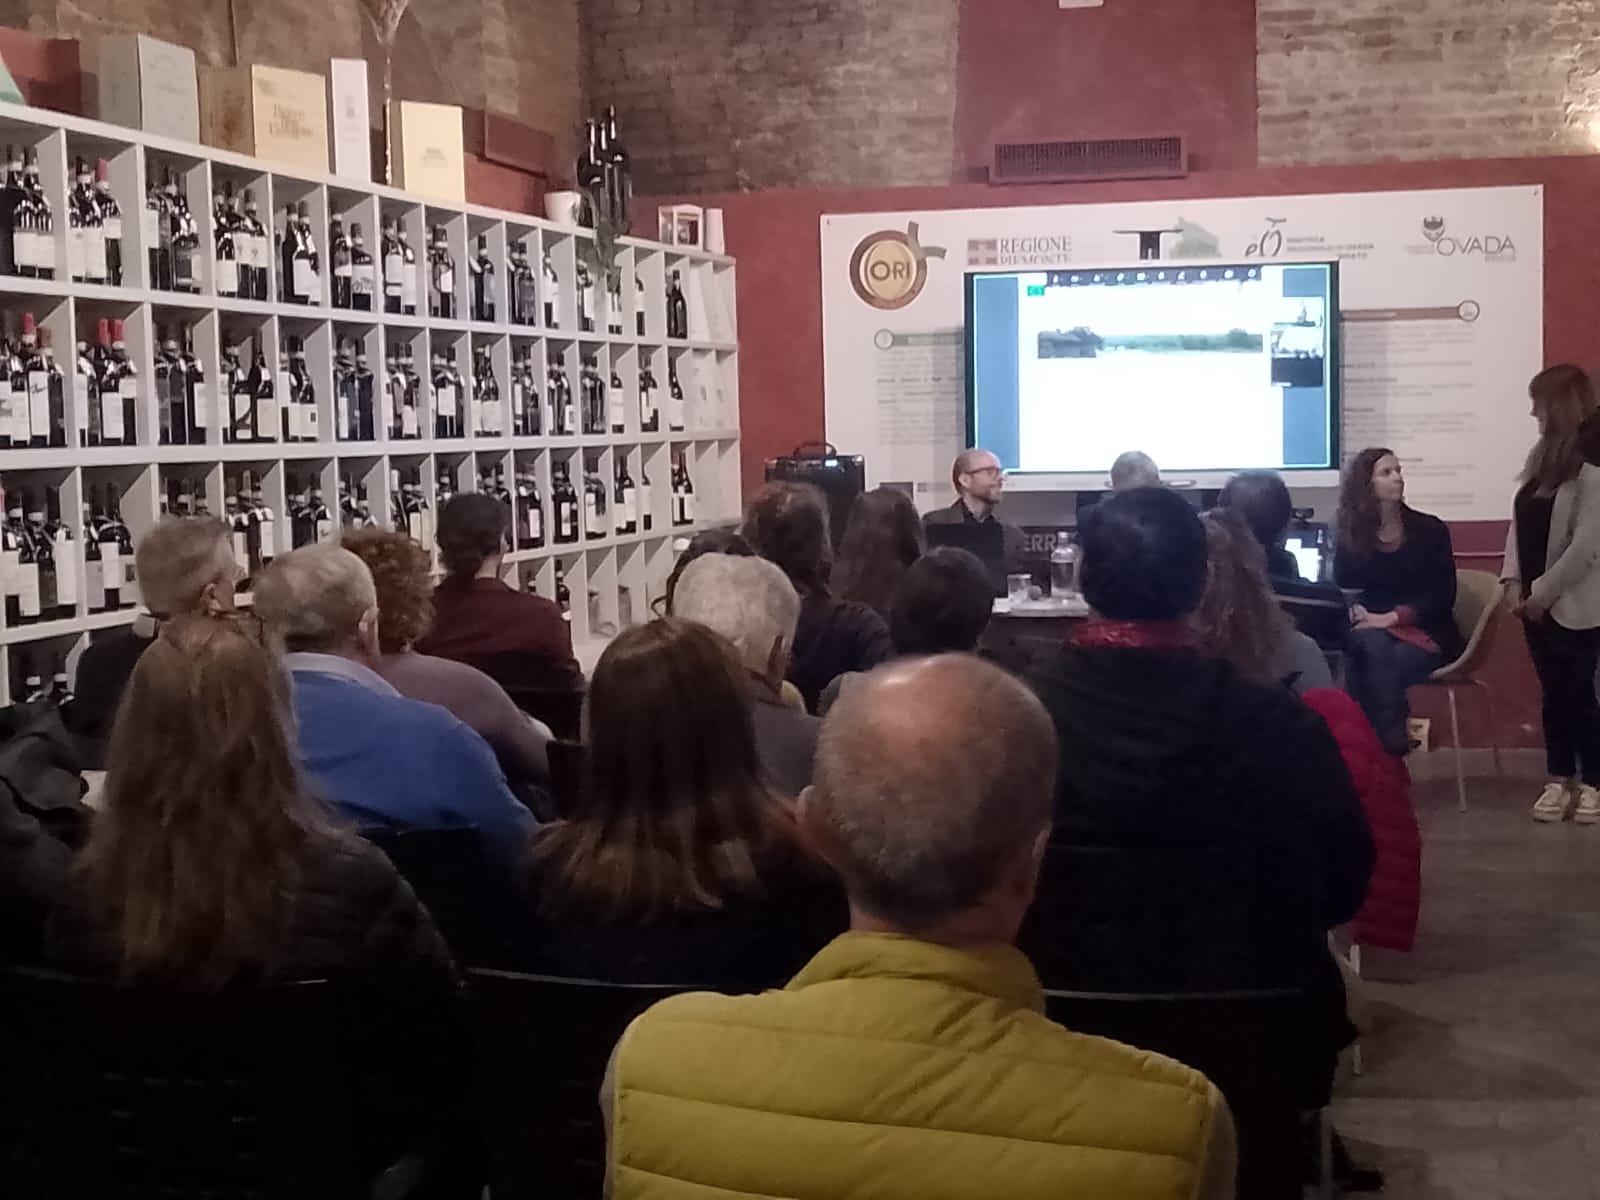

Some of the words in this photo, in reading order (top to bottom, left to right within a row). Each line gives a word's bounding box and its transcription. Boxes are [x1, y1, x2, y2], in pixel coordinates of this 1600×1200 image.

[1000, 236, 1072, 254] REGIONE
[1436, 234, 1517, 257] OVADA
[870, 260, 910, 281] ORI
